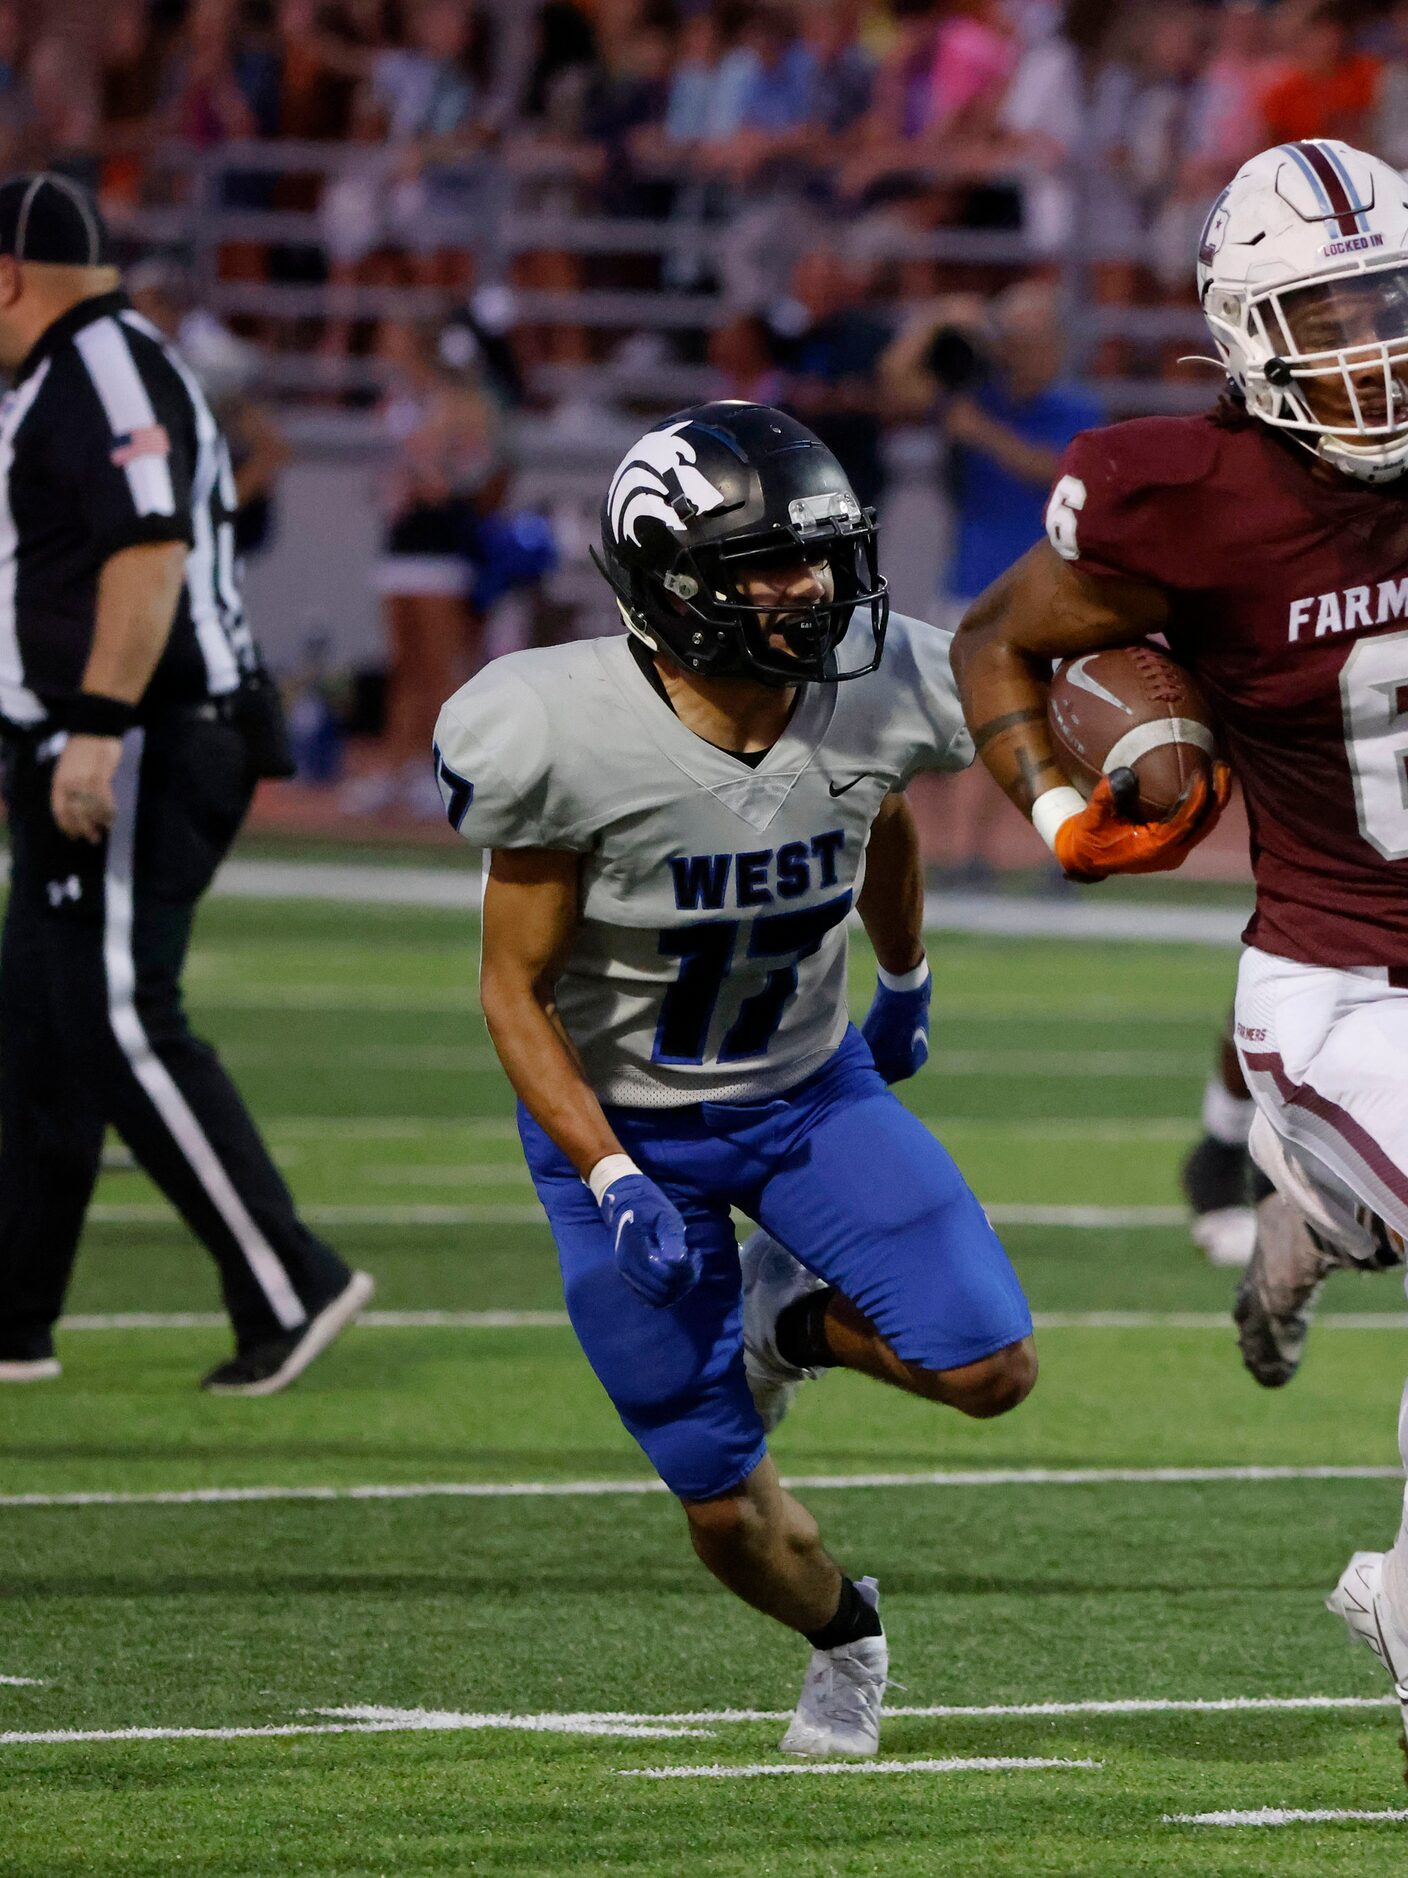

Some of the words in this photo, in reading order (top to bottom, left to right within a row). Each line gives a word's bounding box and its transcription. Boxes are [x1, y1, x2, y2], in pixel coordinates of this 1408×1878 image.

[1323, 238, 1369, 257] LOCKED
[1371, 234, 1384, 248] IN
[1045, 474, 1087, 560] 6
[670, 829, 845, 911] WEST
[651, 888, 854, 1065] 17
